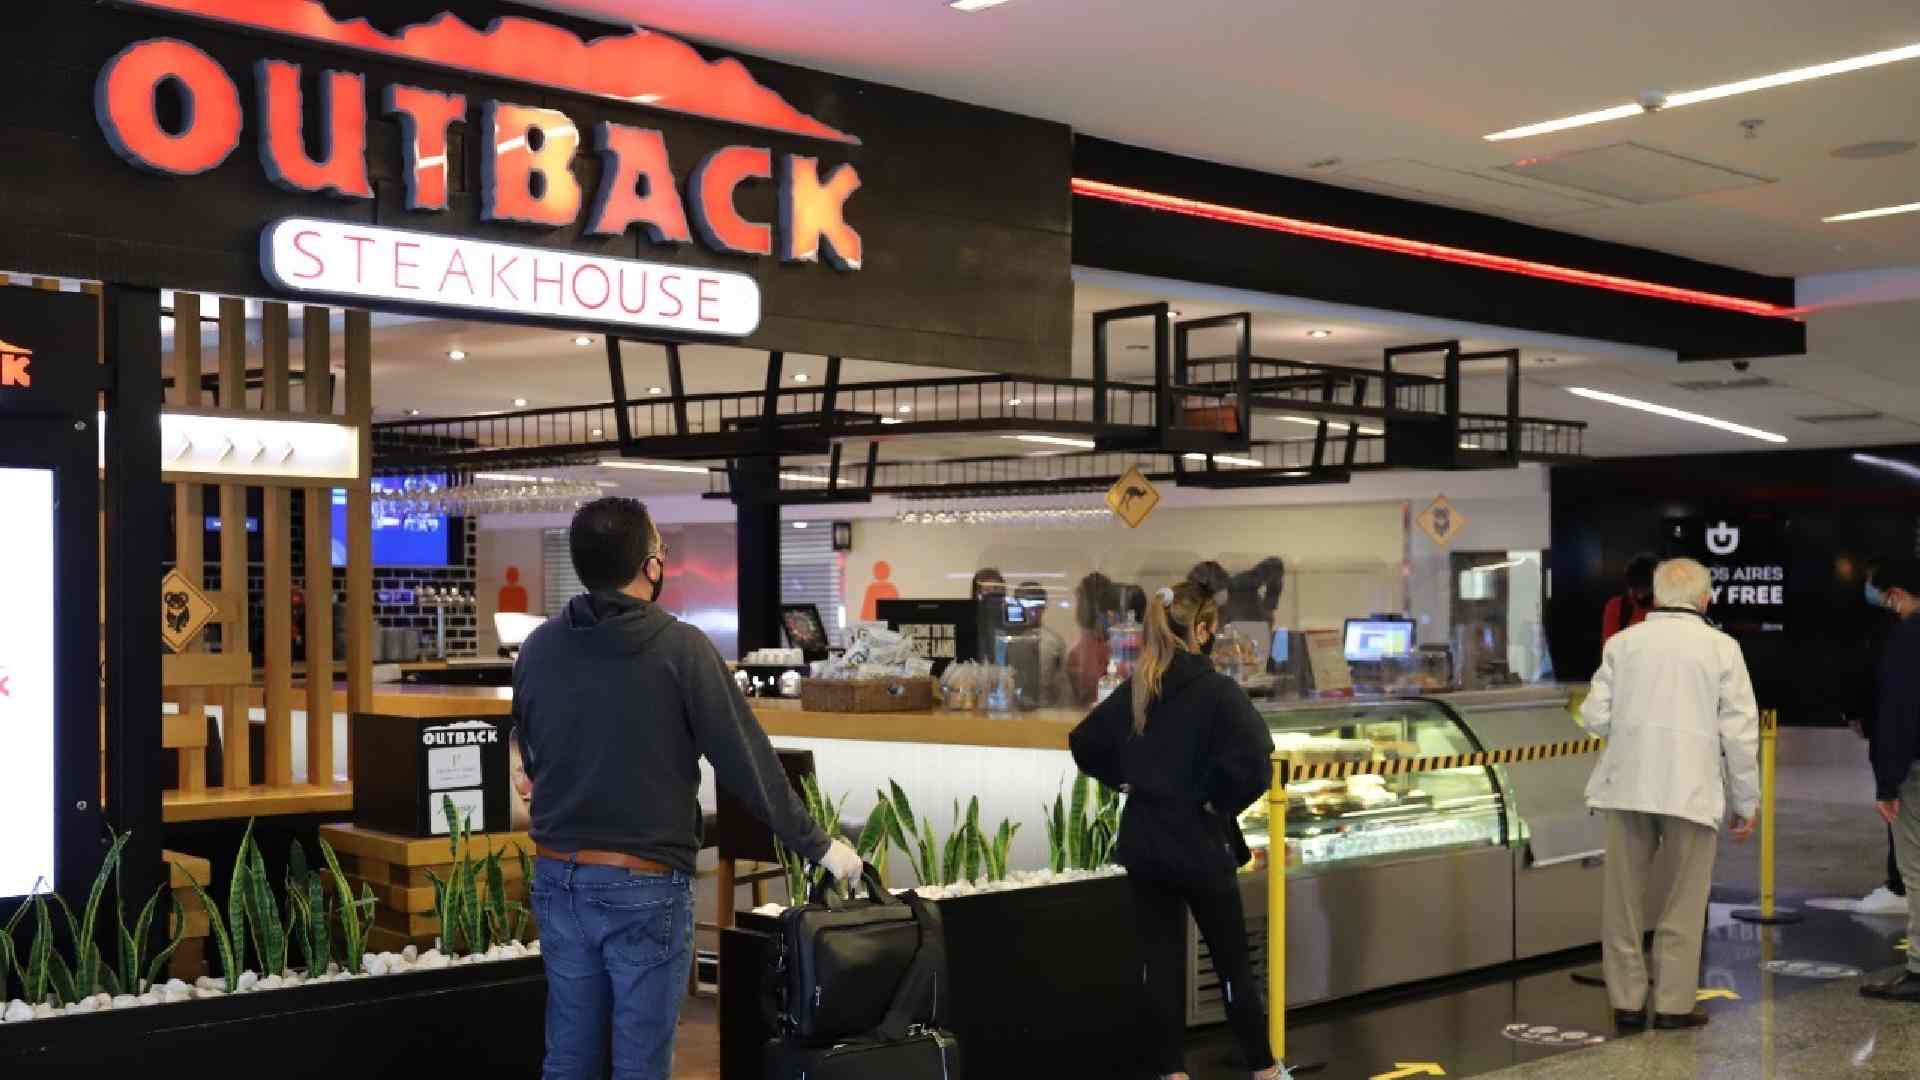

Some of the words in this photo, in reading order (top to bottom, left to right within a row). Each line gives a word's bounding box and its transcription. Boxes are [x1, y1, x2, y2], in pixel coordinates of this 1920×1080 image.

[95, 37, 862, 270] OUTBACK
[292, 230, 720, 323] STEAKHOUSE
[1733, 566, 1784, 581] AIRES
[1727, 585, 1784, 604] FREE
[423, 730, 498, 745] OUTBACK
